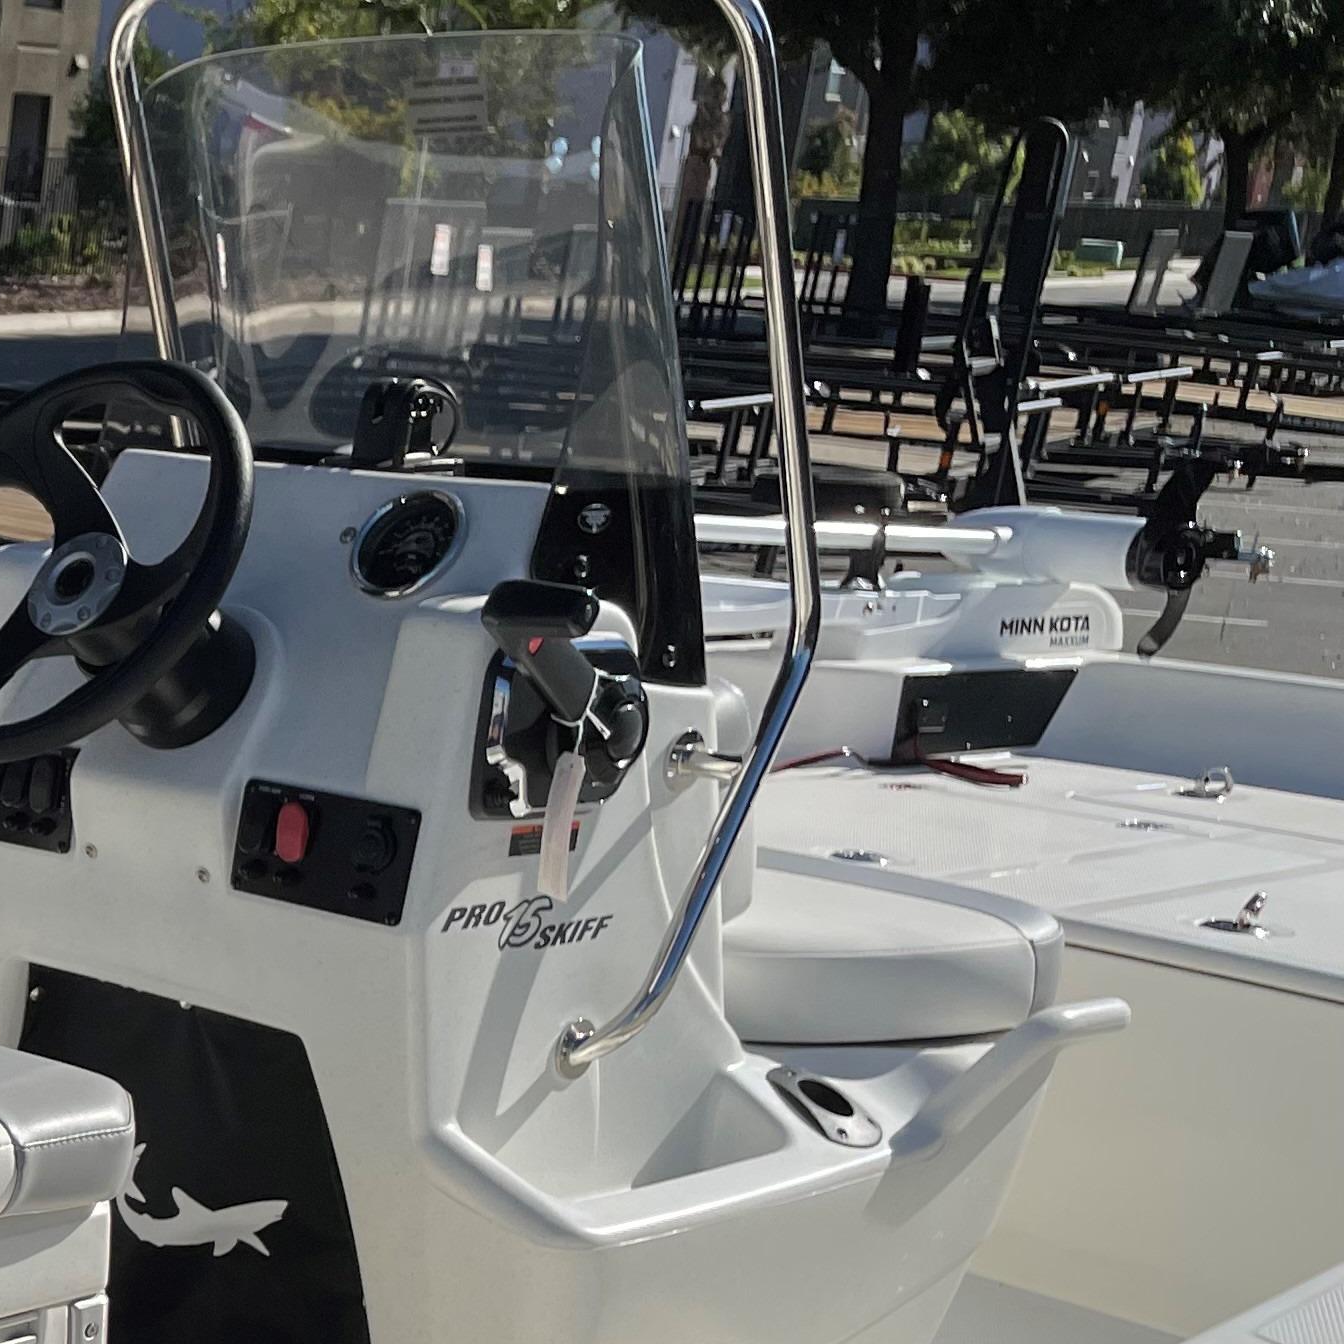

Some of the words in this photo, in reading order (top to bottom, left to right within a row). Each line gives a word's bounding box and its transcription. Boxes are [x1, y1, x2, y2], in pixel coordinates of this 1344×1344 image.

[1000, 616, 1044, 637] MINN
[1049, 615, 1089, 633] KOTA
[441, 901, 506, 933] PRO
[498, 895, 553, 950] 15
[534, 915, 613, 949] SKIFF
